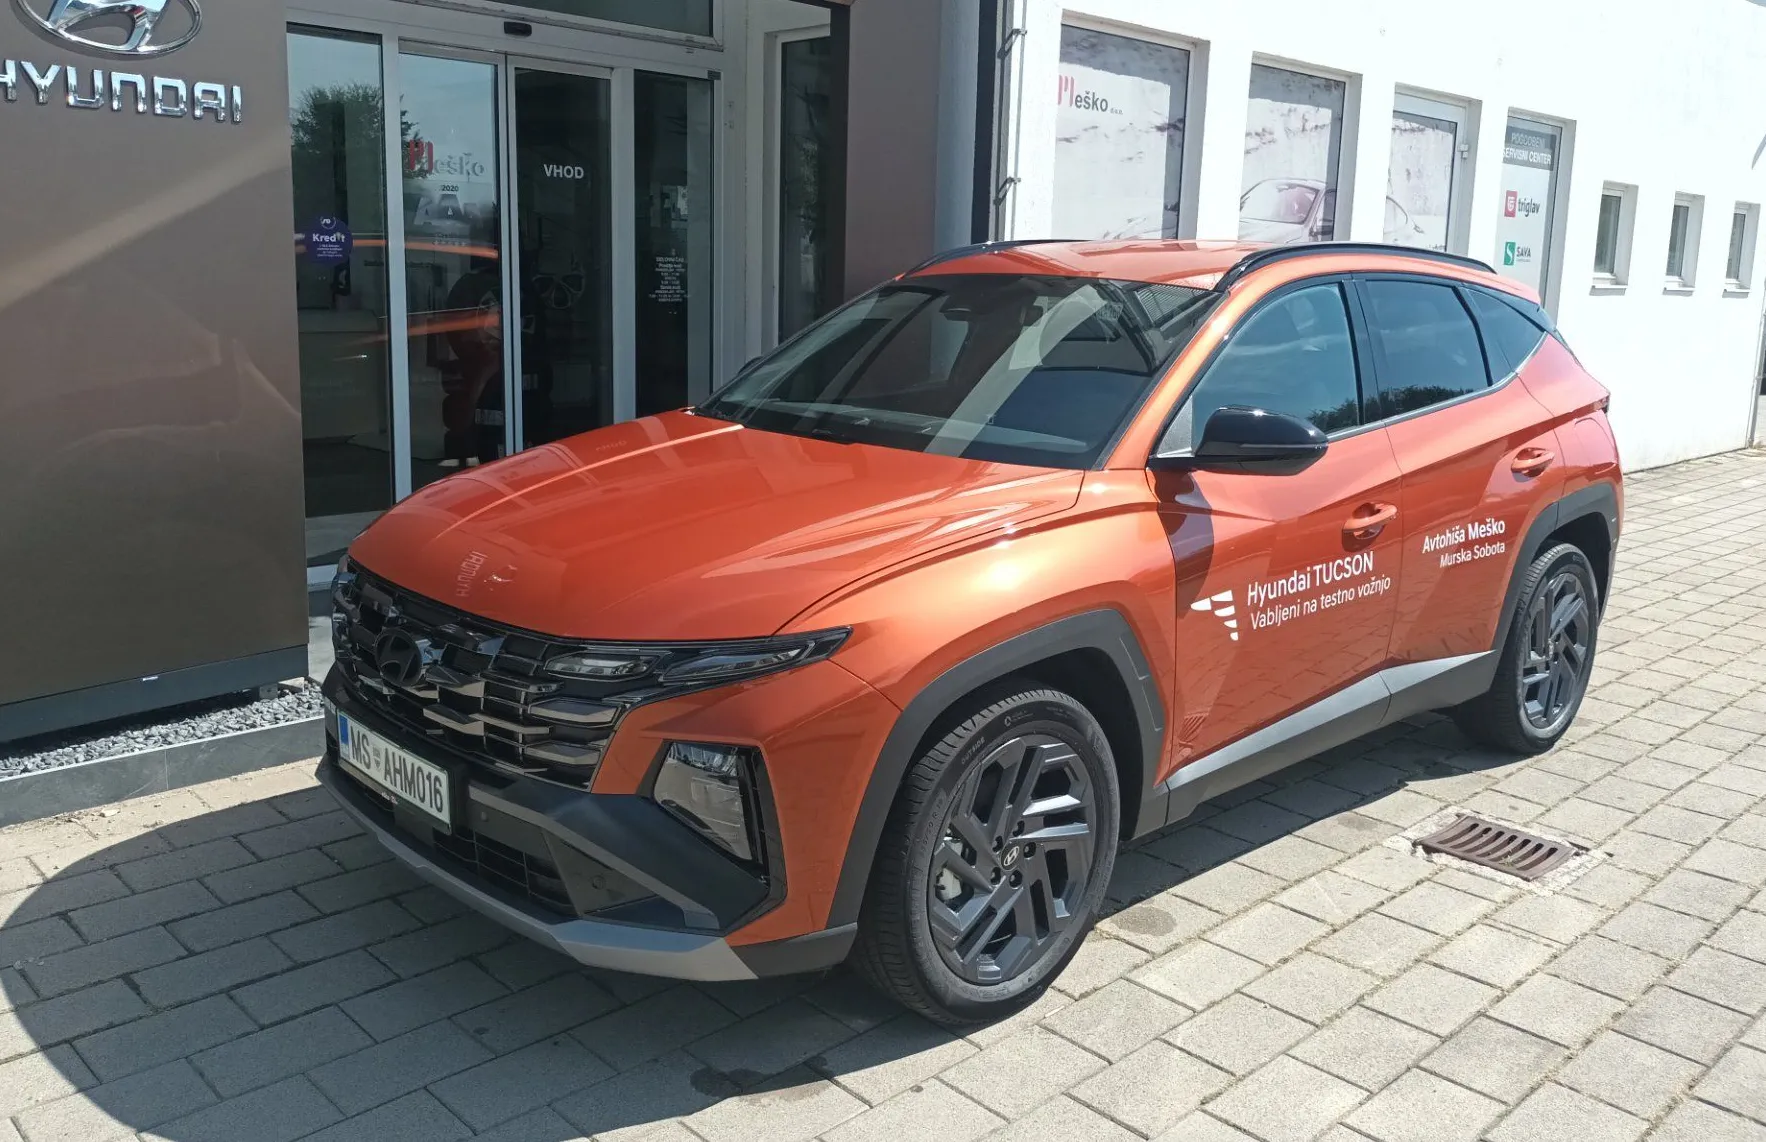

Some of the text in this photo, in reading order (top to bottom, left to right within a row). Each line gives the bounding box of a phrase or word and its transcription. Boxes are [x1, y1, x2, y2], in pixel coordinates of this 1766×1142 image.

[1058, 74, 1108, 112] Meško
[1528, 150, 1552, 165] CENTER
[543, 163, 585, 180] VHOD
[441, 184, 460, 192] 2020
[1517, 197, 1541, 217] triglav
[1516, 246, 1531, 257] SAVA
[1422, 518, 1505, 553] Avtohiša Meško
[1440, 541, 1505, 568] Murska Sobota
[1247, 551, 1374, 607] Hyundai TUCSON
[1251, 574, 1391, 630] Vabljeni na testno vožnjo
[350, 725, 444, 814] MS AHM016
